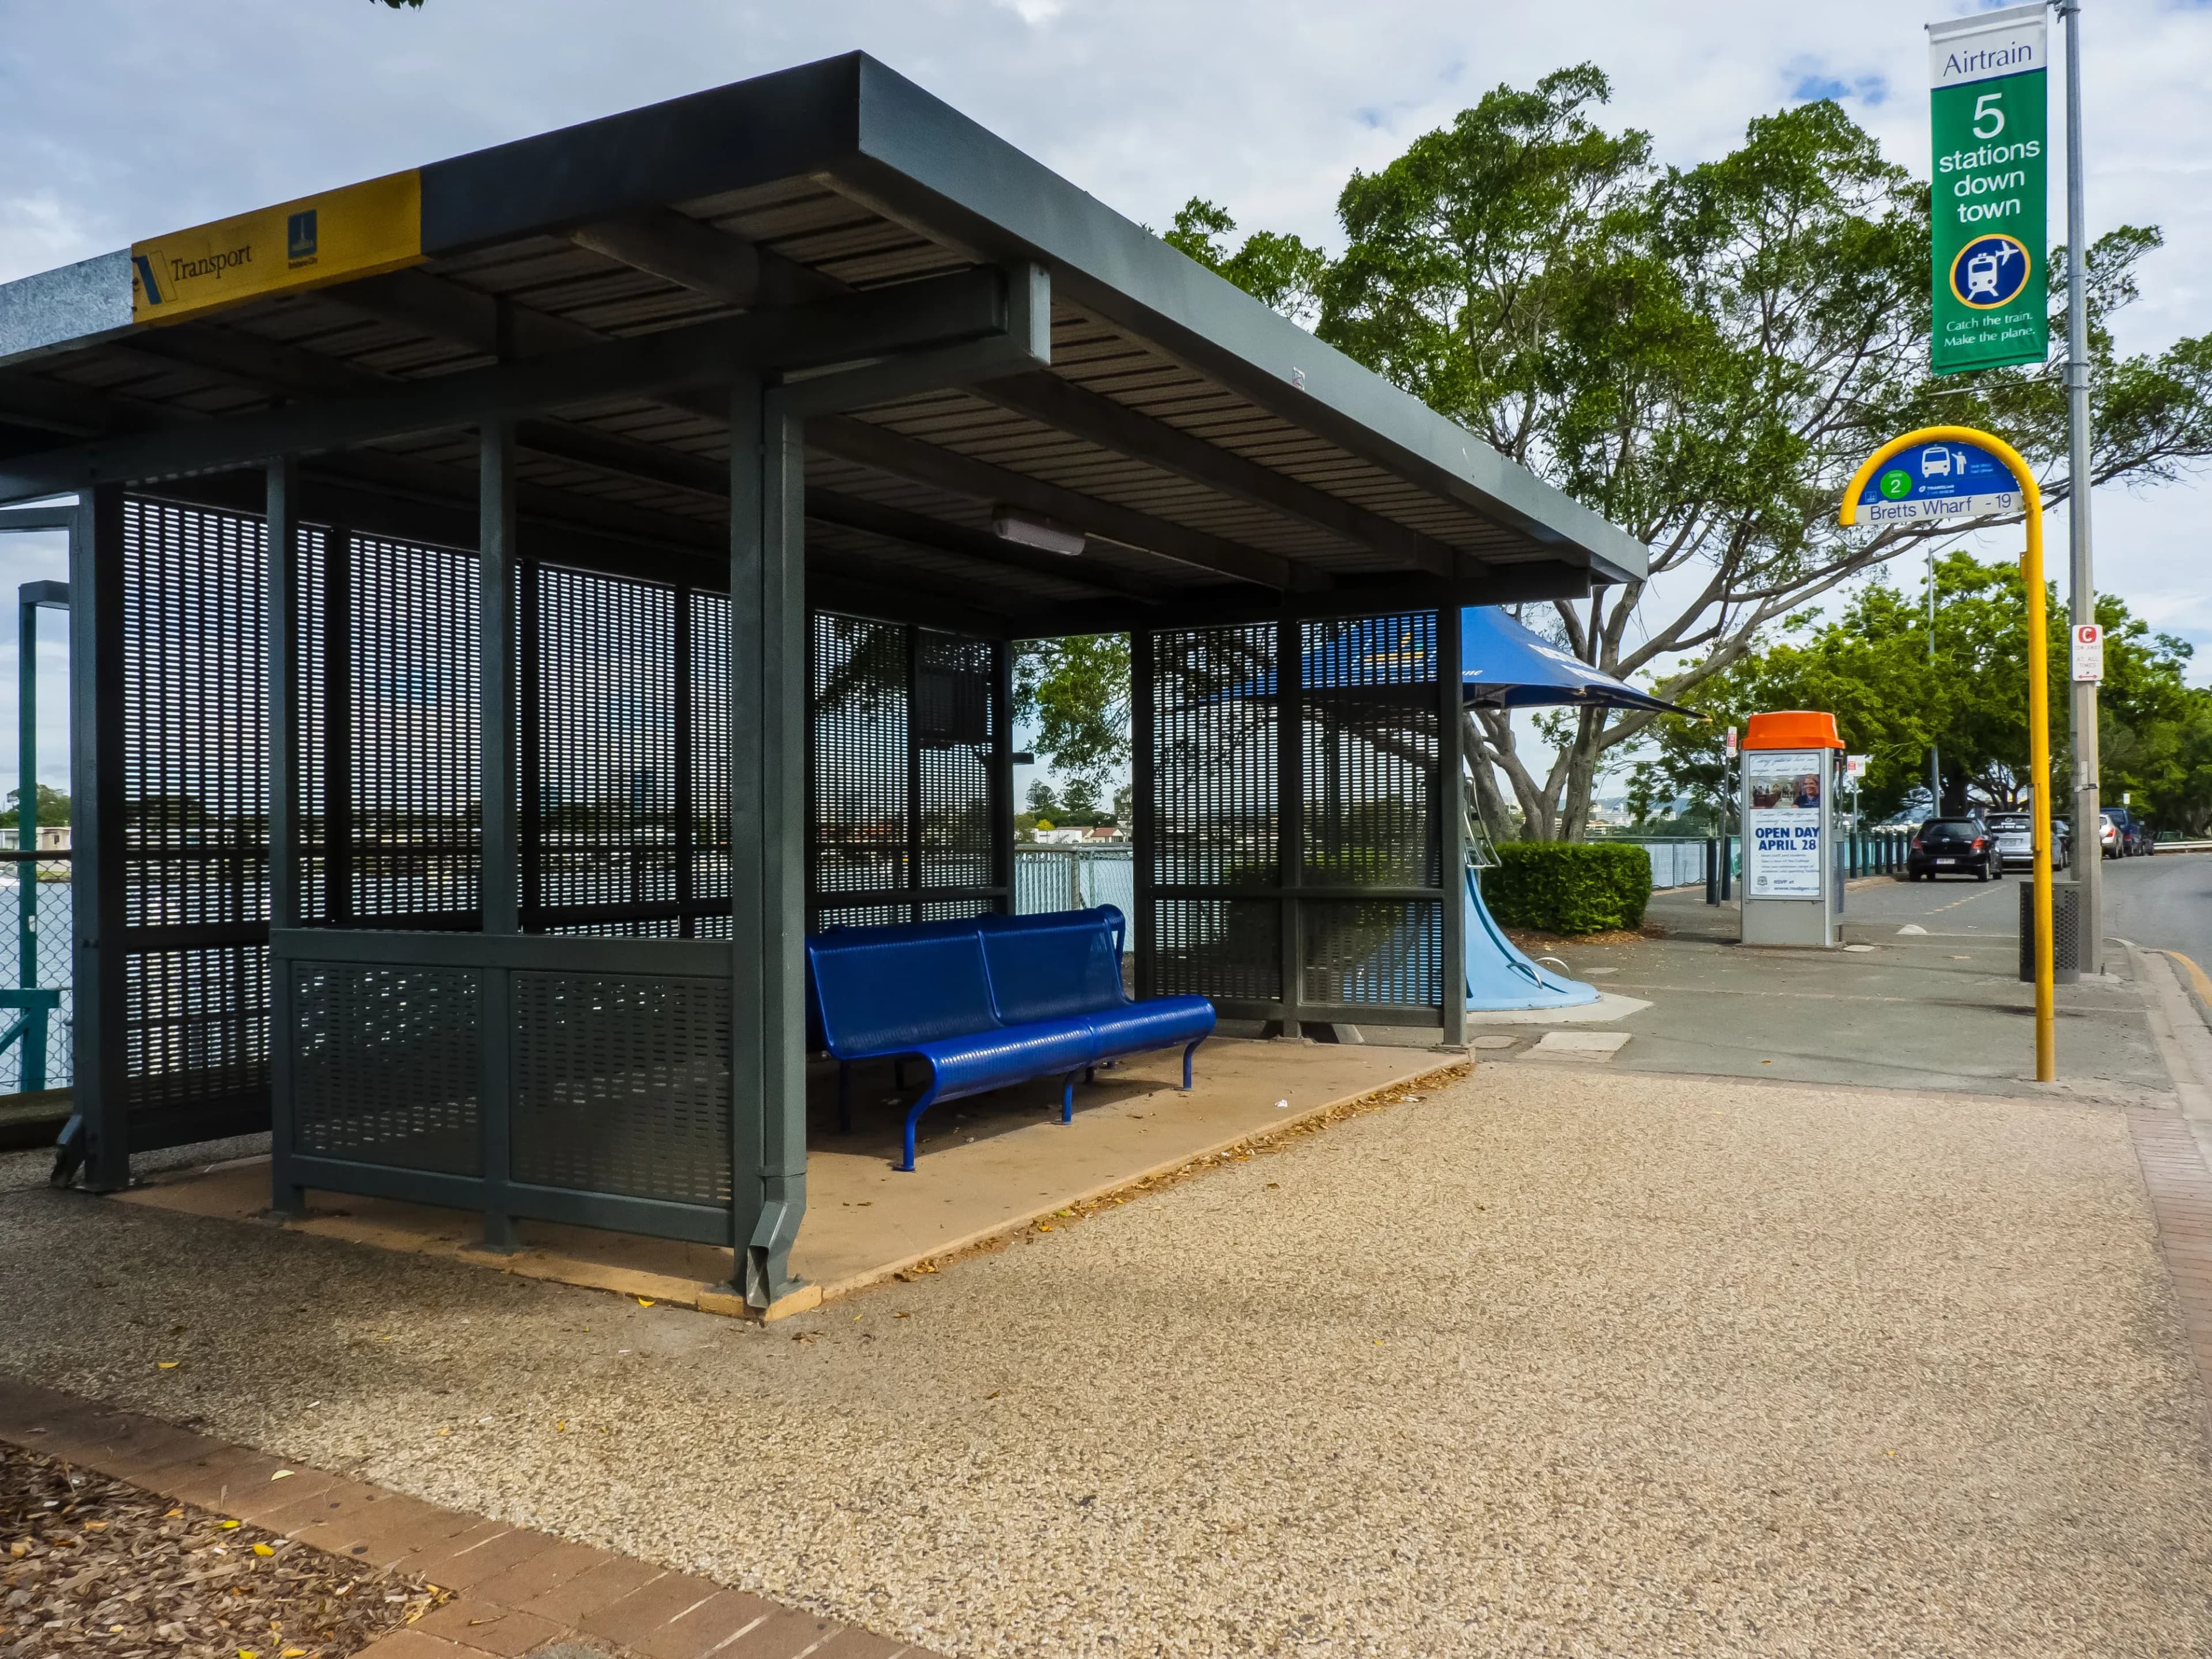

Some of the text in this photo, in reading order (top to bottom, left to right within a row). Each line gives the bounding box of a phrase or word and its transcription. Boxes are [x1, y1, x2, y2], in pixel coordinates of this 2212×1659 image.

[1943, 41, 2032, 77] Airtrain
[1972, 93, 2005, 139] 5
[1939, 140, 2040, 173] stations
[1954, 170, 2024, 197] down
[1957, 198, 2020, 223] town
[171, 244, 252, 281] Transport
[1946, 312, 2033, 332] Catch the train.
[1944, 326, 2036, 347] Make the plane.
[1891, 479, 1901, 493] 2
[1870, 504, 1916, 521] Bretts
[1922, 497, 1972, 515] Wharf
[2082, 628, 2093, 642] C
[1755, 826, 1820, 838] OPEN DAY
[1759, 839, 1816, 850] APRIL 28
